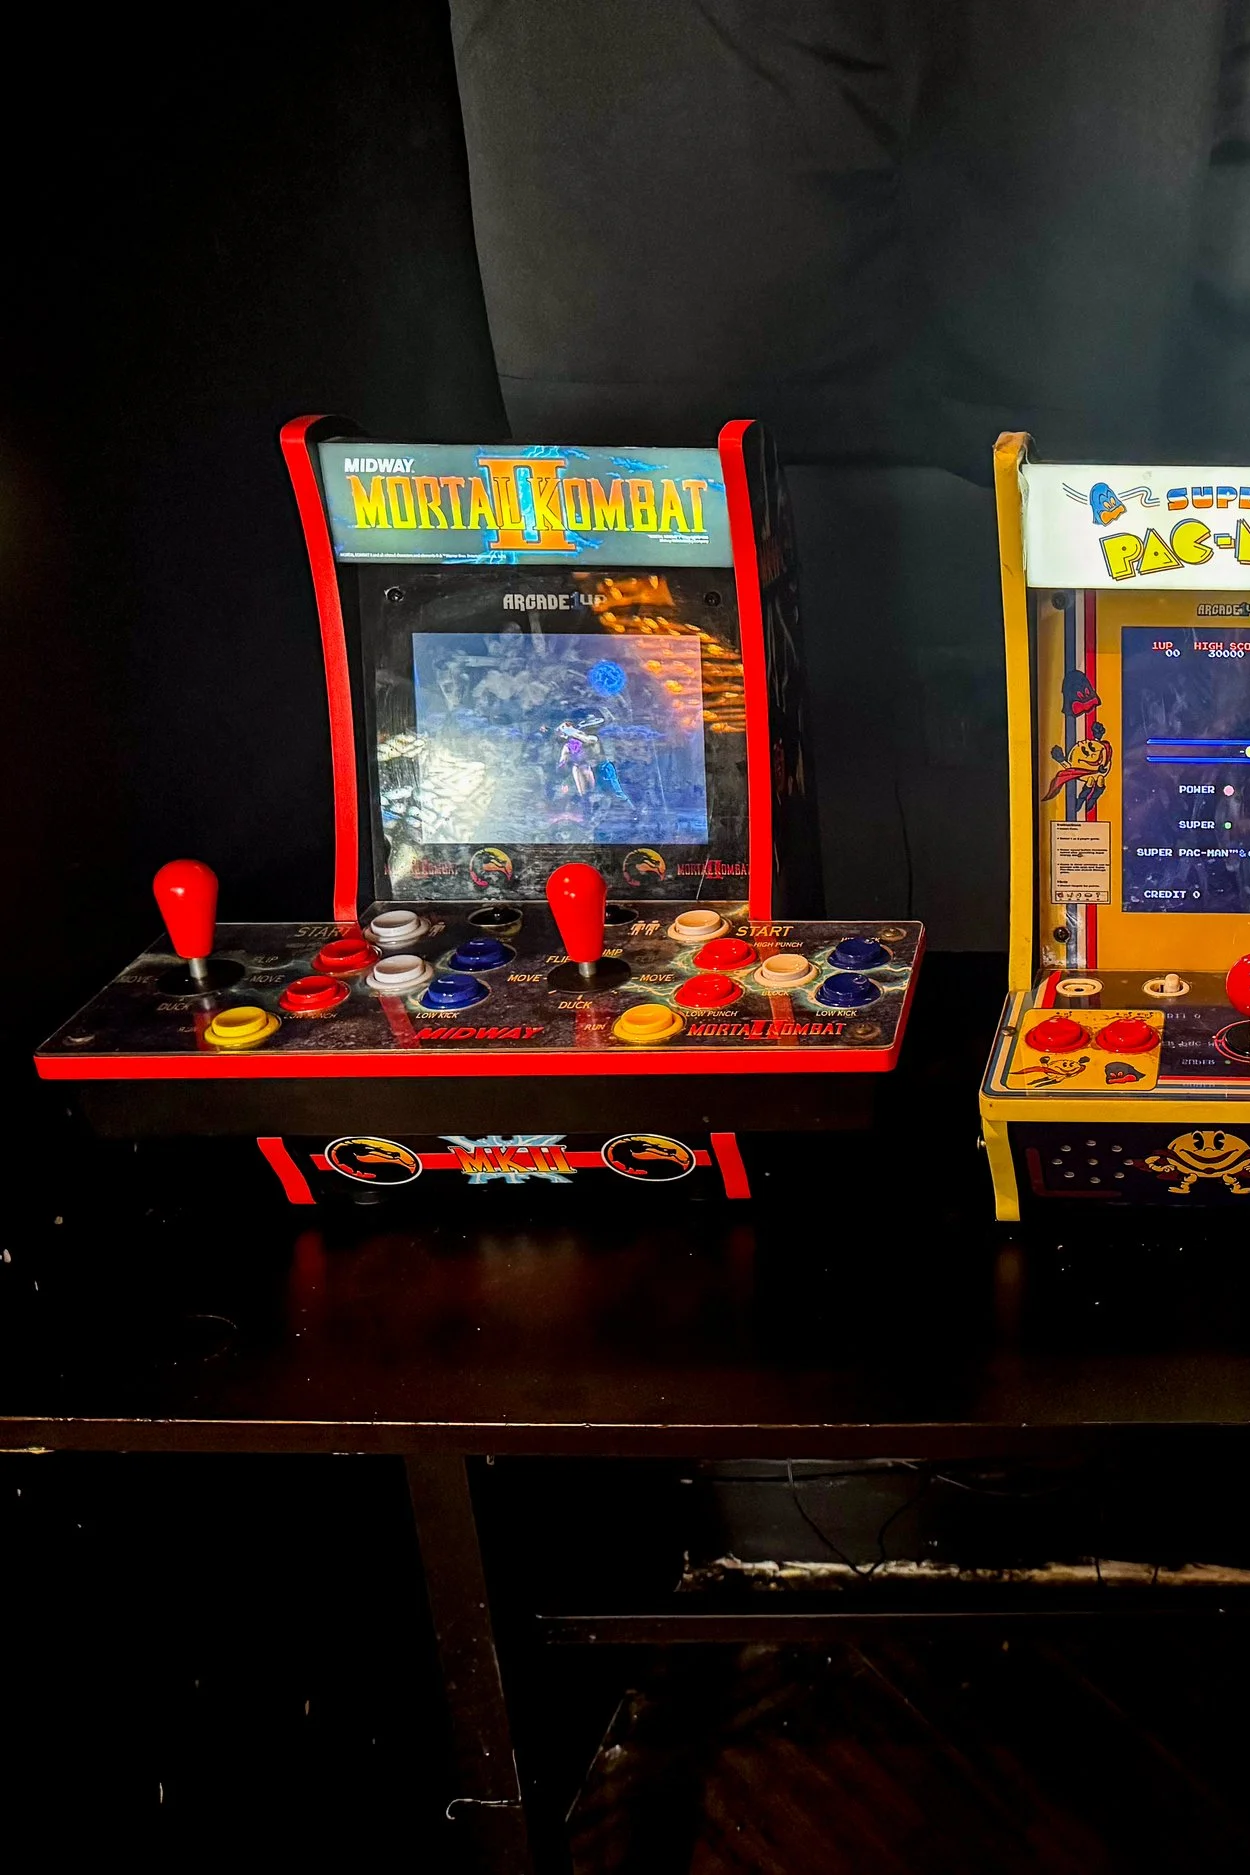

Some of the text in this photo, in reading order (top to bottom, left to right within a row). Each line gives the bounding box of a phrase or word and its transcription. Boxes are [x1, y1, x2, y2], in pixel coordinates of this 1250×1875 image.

[345, 475, 709, 533] MORTAL KOMBAT
[1152, 641, 1174, 650] 1UP
[1193, 641, 1224, 650] HIGH
[1207, 649, 1244, 658] 30000
[1178, 785, 1215, 794] POWER
[1178, 820, 1215, 829] SUPER
[1136, 848, 1173, 857] SUPER
[1143, 890, 1187, 899] CREDIT
[294, 926, 353, 937] START
[735, 925, 794, 937] START
[249, 974, 286, 983] MOVE
[507, 974, 541, 983] MOVE
[639, 973, 675, 982] MOVE
[558, 1001, 593, 1010] DUCK
[584, 1023, 606, 1031] RUN
[686, 1021, 847, 1037] MORTAL KOMBAT
[414, 1026, 545, 1041] MIDWAY
